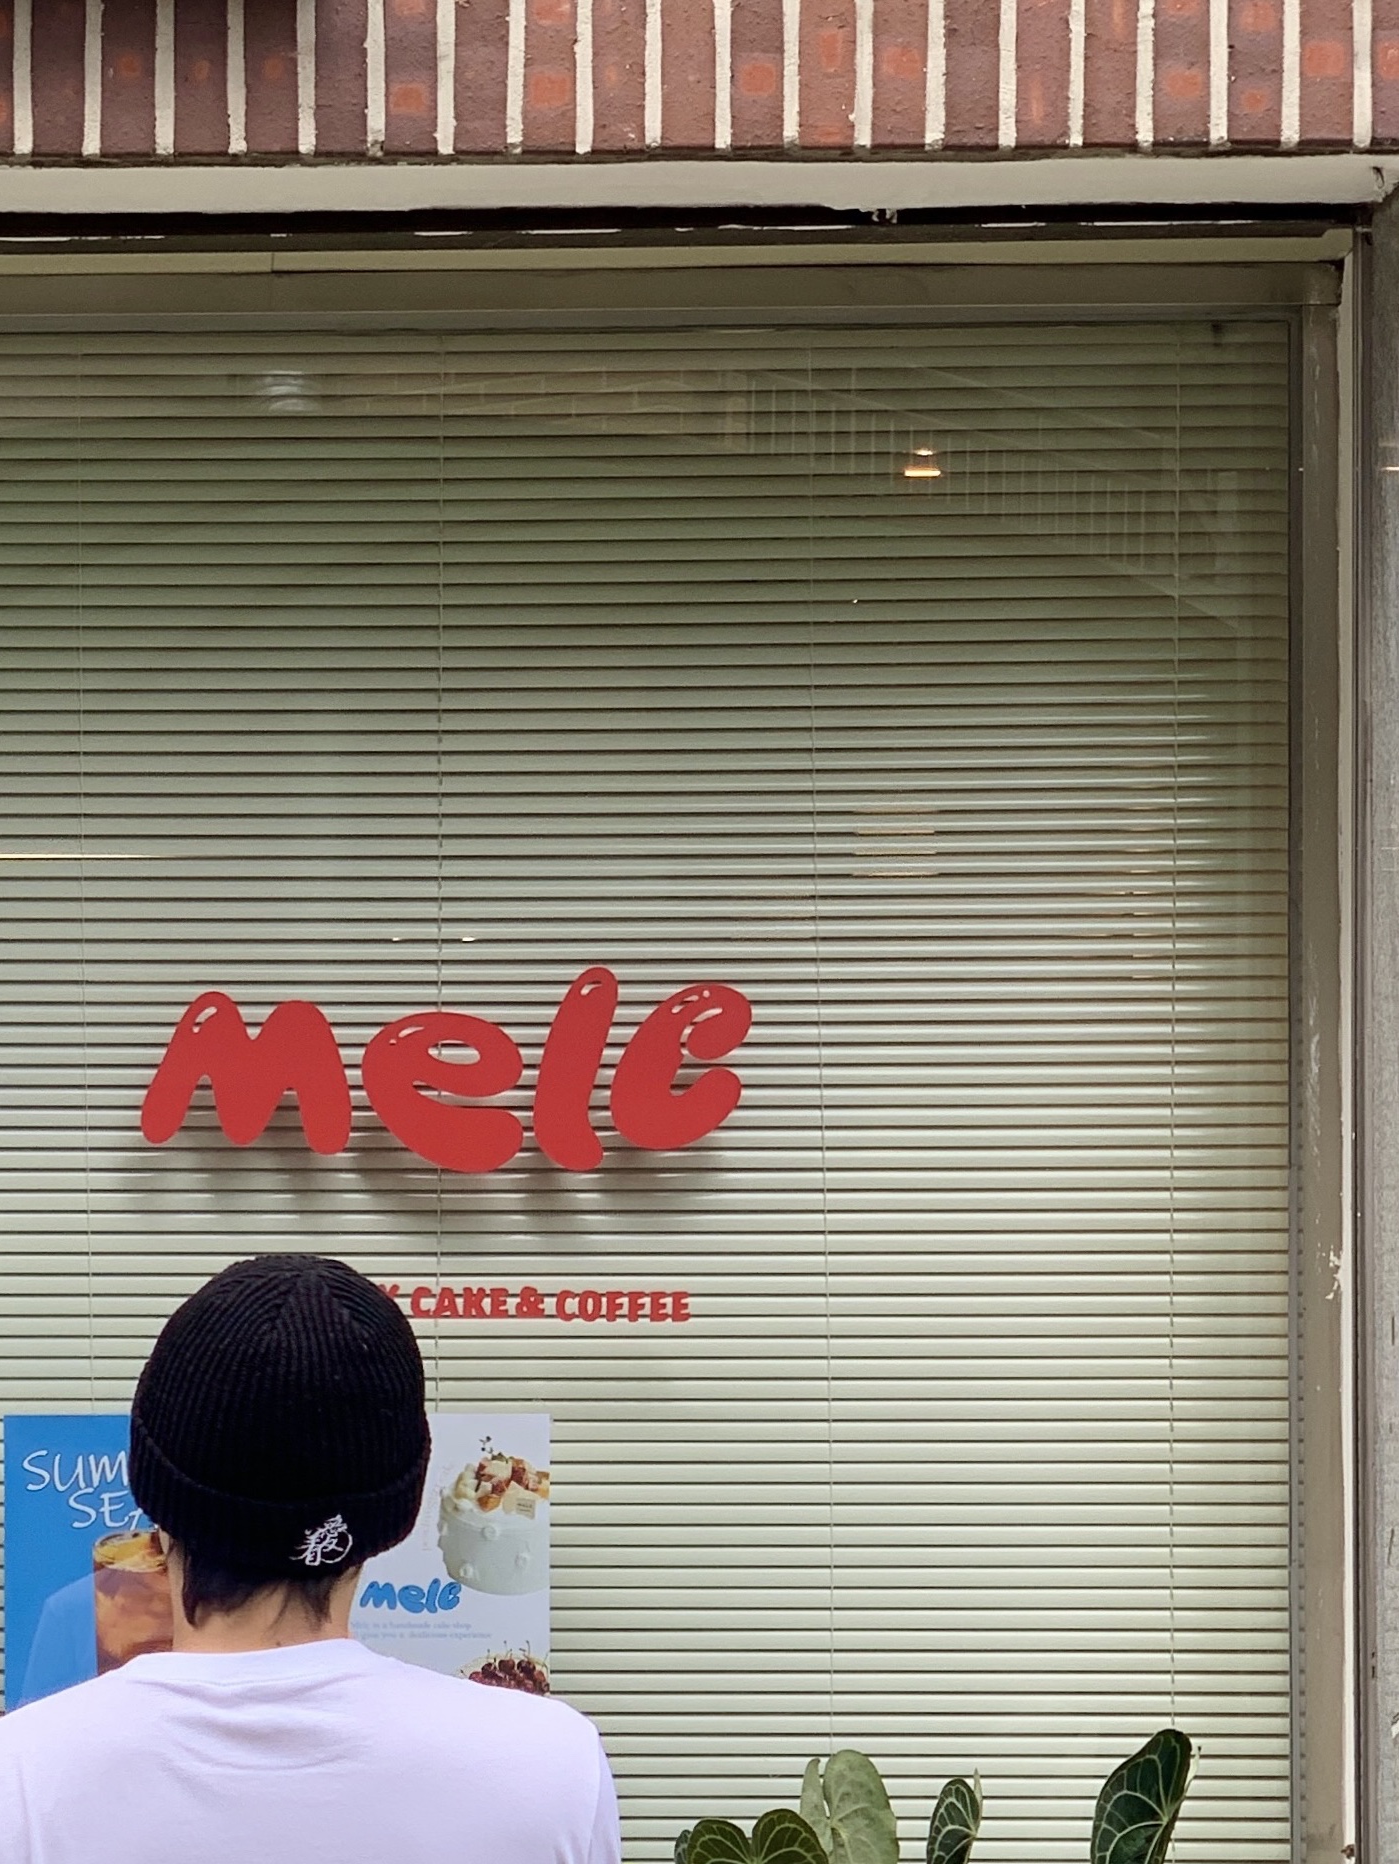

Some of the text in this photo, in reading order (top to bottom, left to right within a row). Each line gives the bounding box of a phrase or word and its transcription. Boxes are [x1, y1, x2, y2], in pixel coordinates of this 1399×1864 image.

[410, 1285, 510, 1319] CAKE
[514, 1285, 546, 1319] &
[554, 1289, 692, 1323] COFFEE
[22, 1449, 130, 1493] SUM
